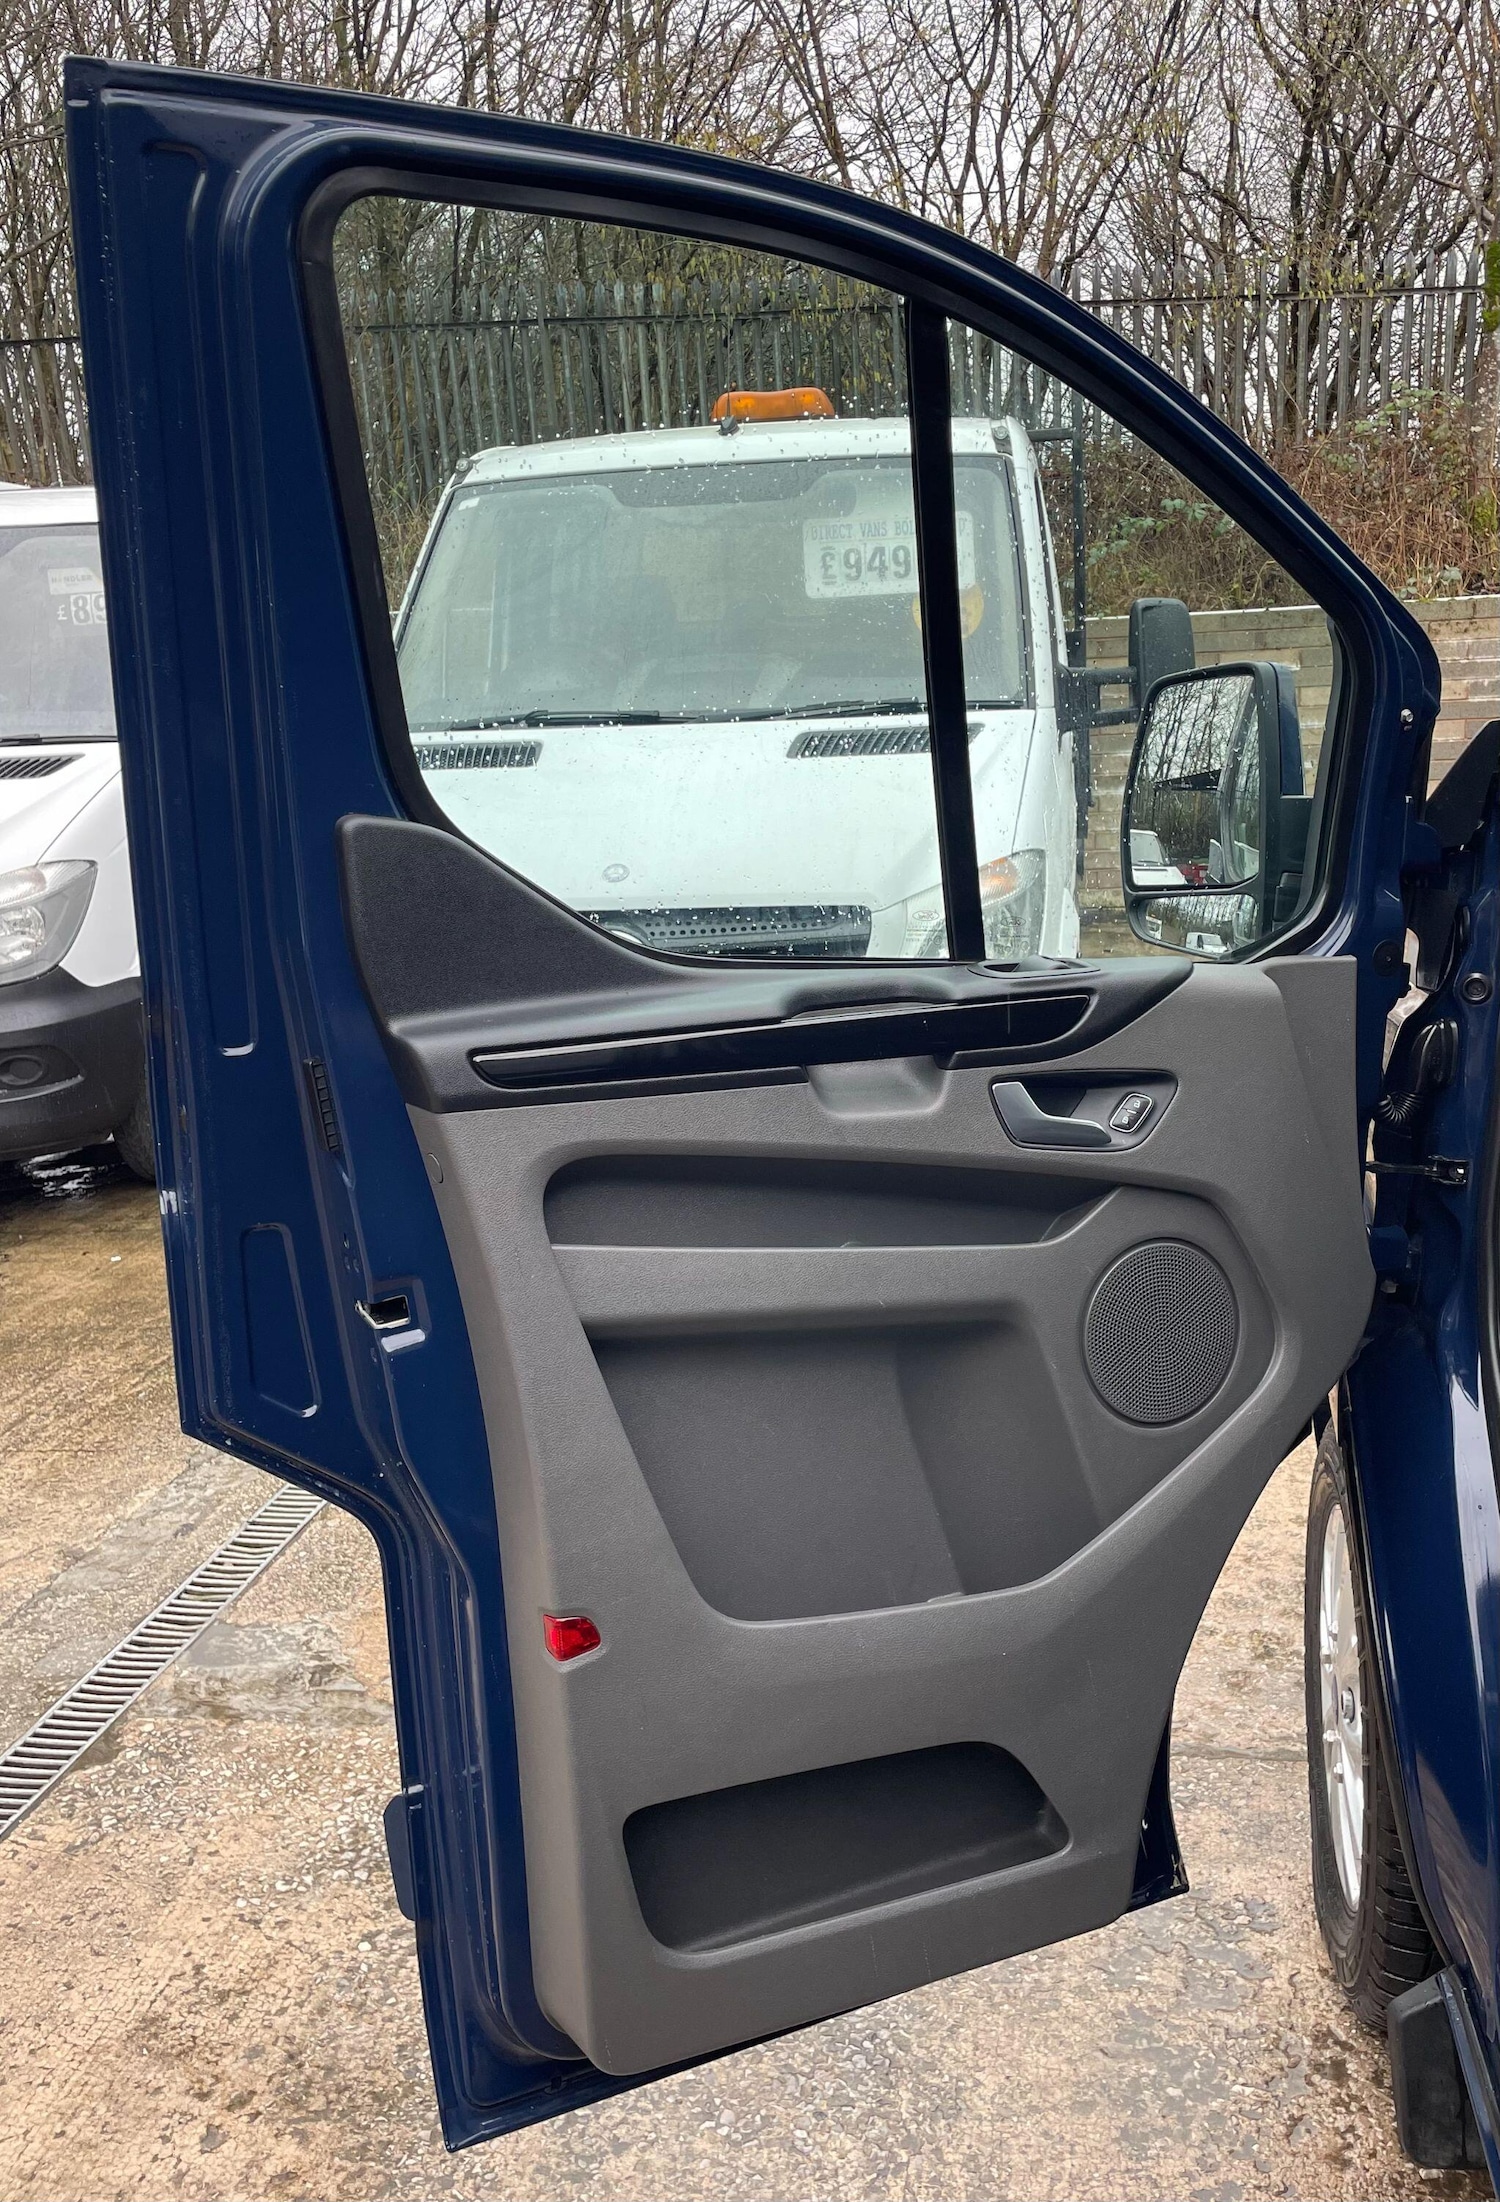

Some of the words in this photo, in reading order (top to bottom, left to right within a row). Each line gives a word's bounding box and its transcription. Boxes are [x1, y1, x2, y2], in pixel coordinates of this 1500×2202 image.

[812, 523, 853, 540] DIRECT
[861, 521, 888, 538] VANS
[894, 519, 915, 534] BOL
[821, 545, 913, 585] £949
[57, 595, 106, 624] £89
